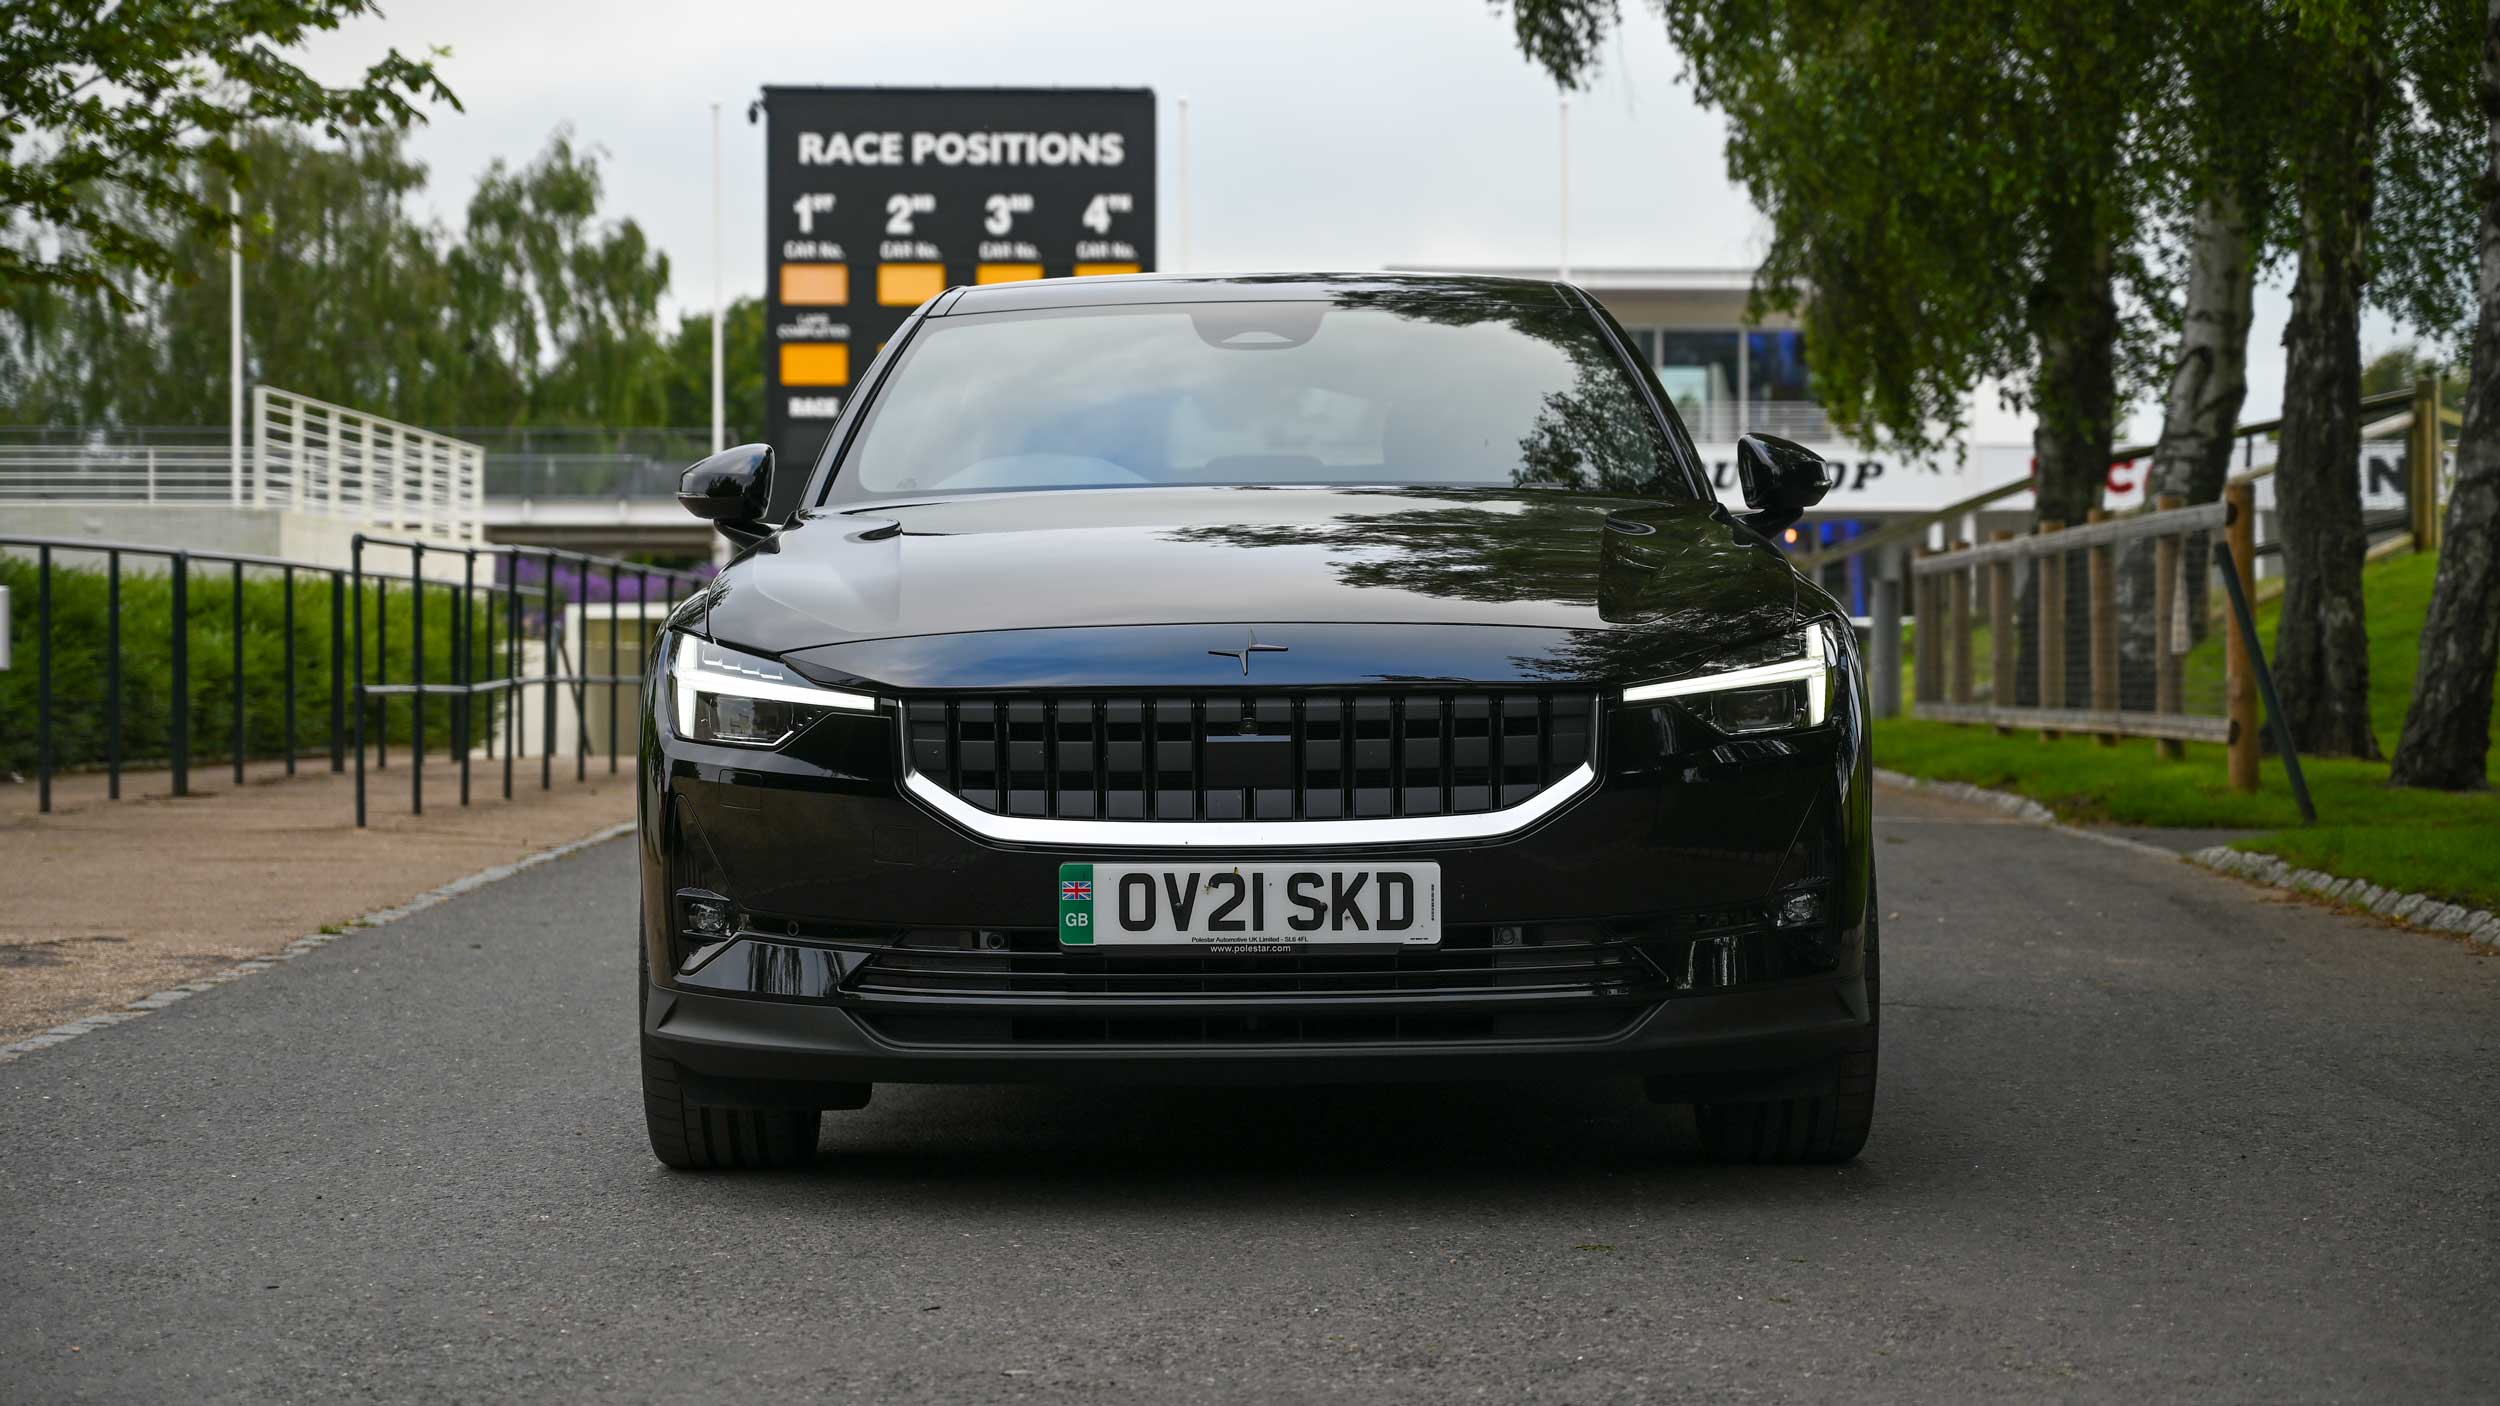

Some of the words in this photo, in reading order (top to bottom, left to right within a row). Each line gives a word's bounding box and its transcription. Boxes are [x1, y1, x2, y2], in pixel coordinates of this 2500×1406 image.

[799, 132, 903, 165] RACE
[912, 132, 1124, 165] POSITIONS
[1118, 872, 1264, 931] OV21
[1286, 872, 1414, 931] SKD
[1065, 913, 1089, 926] GB
[1210, 944, 1291, 954] www.polestar.com
